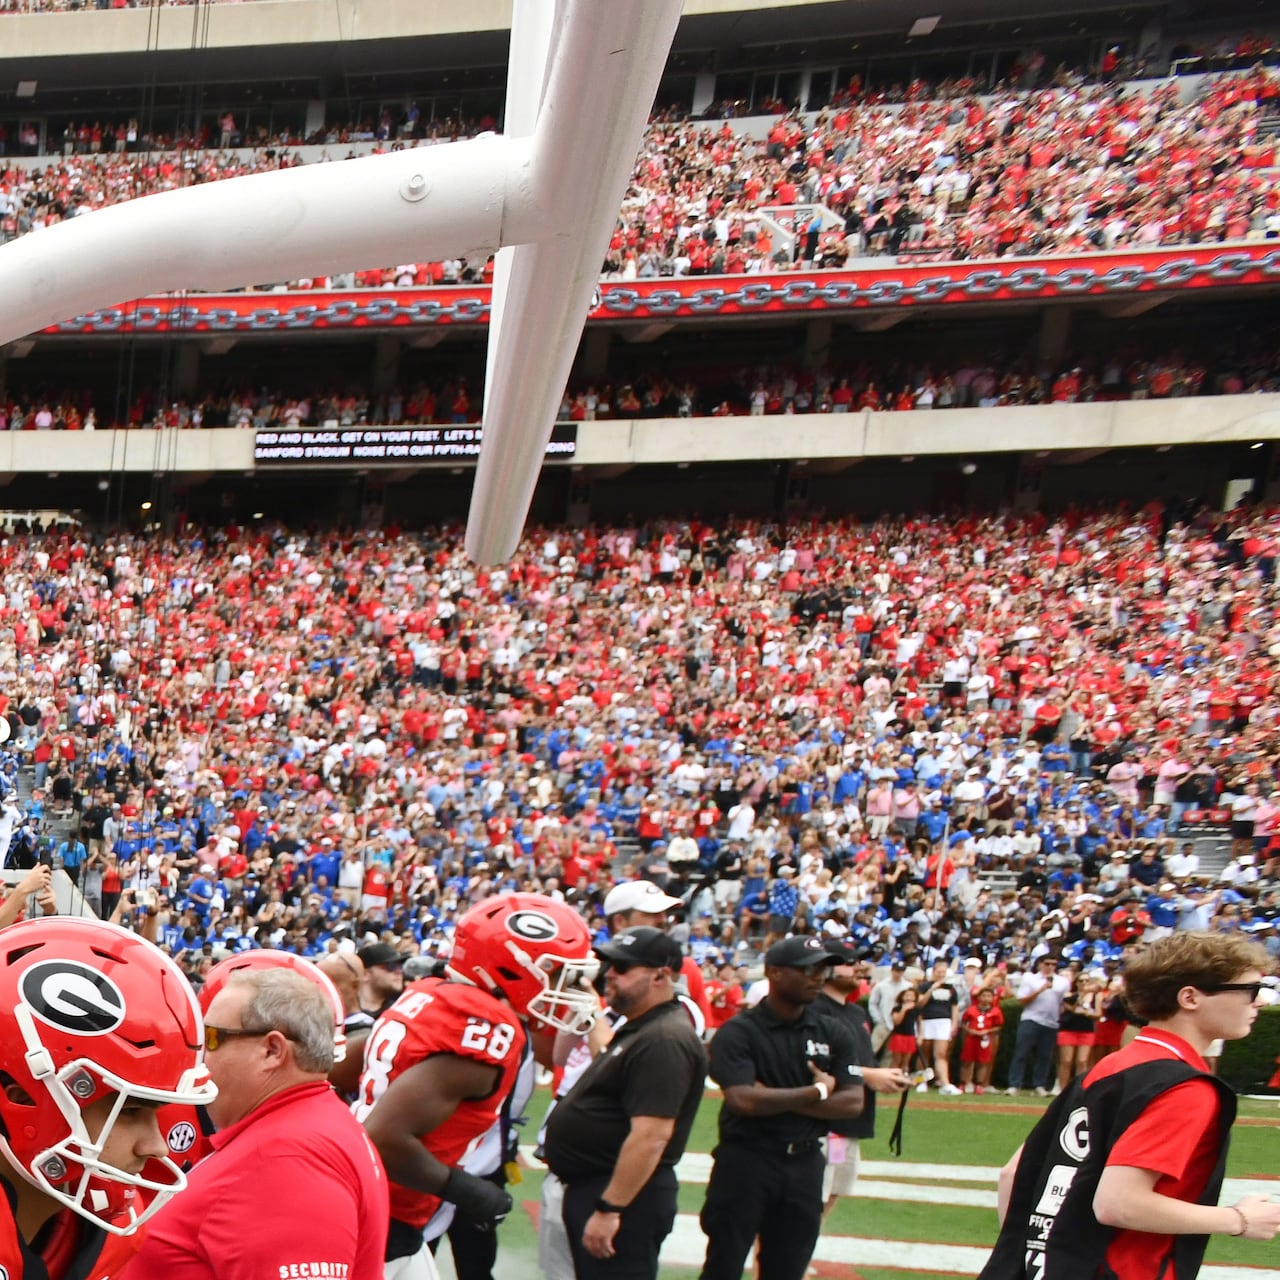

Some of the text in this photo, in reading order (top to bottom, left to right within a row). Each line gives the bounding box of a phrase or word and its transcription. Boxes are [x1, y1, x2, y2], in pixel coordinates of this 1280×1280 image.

[255, 447, 304, 458] SANFORD
[304, 446, 351, 457] STADIUM
[353, 446, 385, 456] NOISE
[386, 445, 409, 456] FOR
[409, 445, 433, 455] OUR
[256, 433, 278, 443] RED
[278, 433, 301, 443] AND
[341, 432, 364, 442] GET
[364, 431, 381, 441] ON
[381, 431, 410, 441] YOUR
[508, 912, 556, 940] G
[23, 962, 122, 1031] G
[461, 1017, 515, 1060] 28
[169, 1122, 195, 1152] SEC
